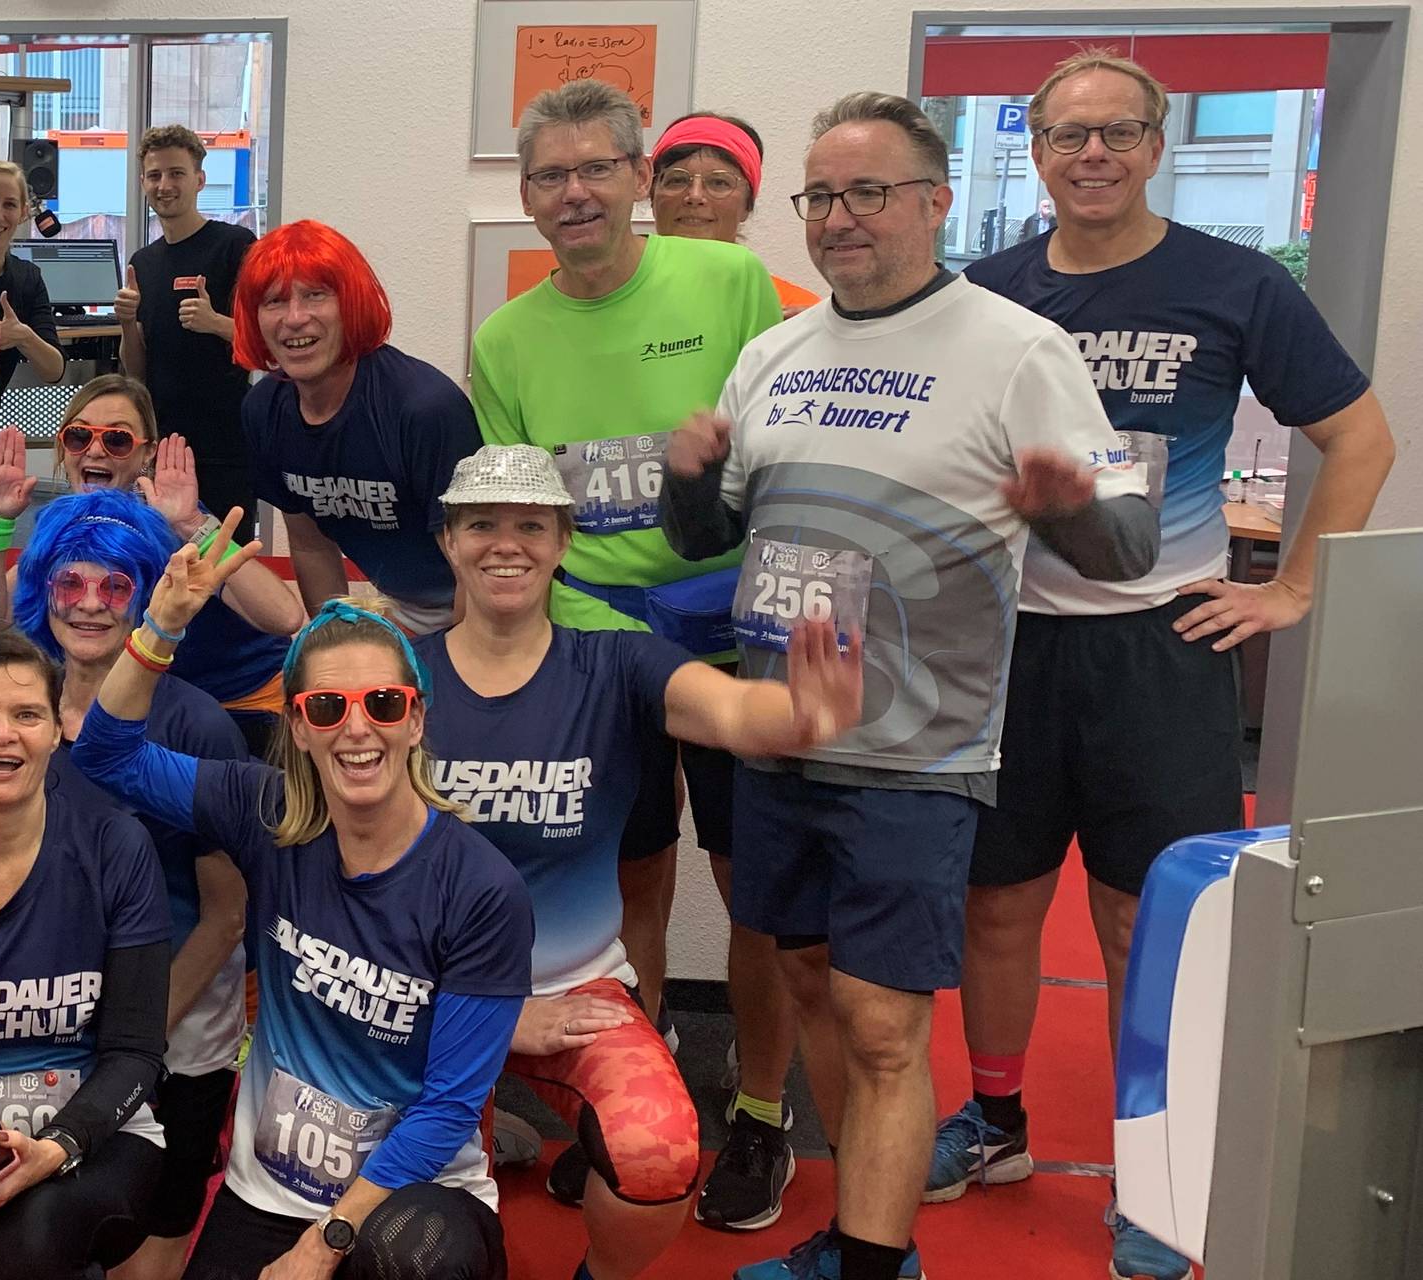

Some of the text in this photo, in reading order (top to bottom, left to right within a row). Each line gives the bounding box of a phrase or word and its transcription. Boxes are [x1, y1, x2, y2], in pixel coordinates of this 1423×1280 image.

[1003, 108, 1022, 129] P
[660, 334, 703, 353] bunert
[769, 367, 936, 402] AUSDAUERSCHULE
[1130, 391, 1174, 404] bunert
[766, 402, 910, 433] by bunert
[637, 440, 654, 449] BIG
[282, 472, 399, 502] AUSDAUER
[586, 461, 664, 503] 416
[313, 497, 398, 522] SCHULE
[753, 572, 833, 624] 256
[430, 757, 593, 793] USDAUER
[542, 824, 582, 838] bunert
[266, 915, 434, 1005] AUSDAUER
[291, 962, 419, 1034] SCHULE
[368, 1026, 410, 1046] bunert
[19, 1077, 39, 1087] BIG
[348, 1114, 369, 1128] BIG
[300, 1181, 324, 1197] bunert
